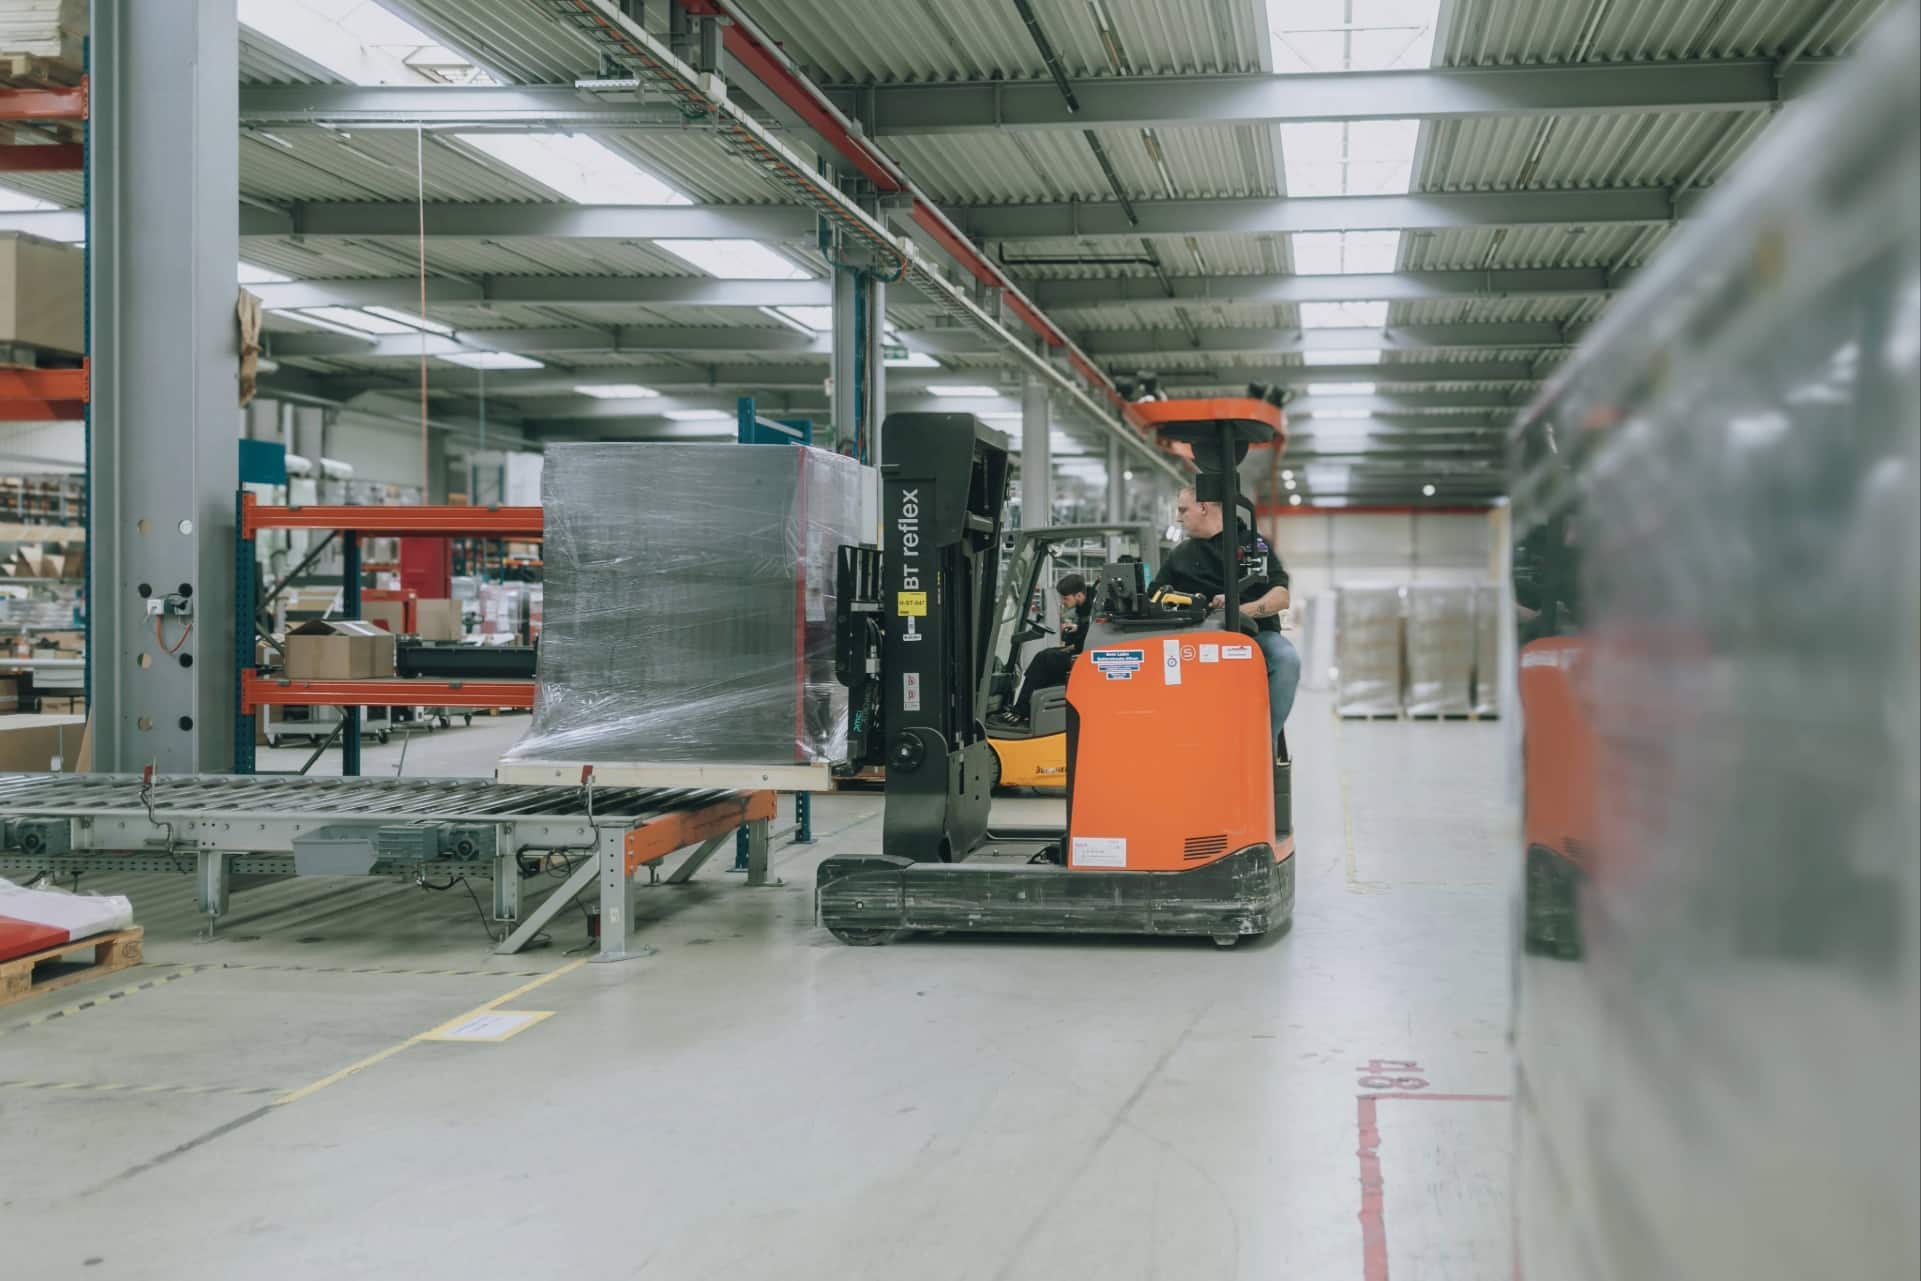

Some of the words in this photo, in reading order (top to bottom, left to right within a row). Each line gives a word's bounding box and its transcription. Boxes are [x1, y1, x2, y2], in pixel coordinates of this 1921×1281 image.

[897, 488, 920, 557] reflex
[903, 563, 920, 590] BT
[1355, 1059, 1430, 1090] 48
